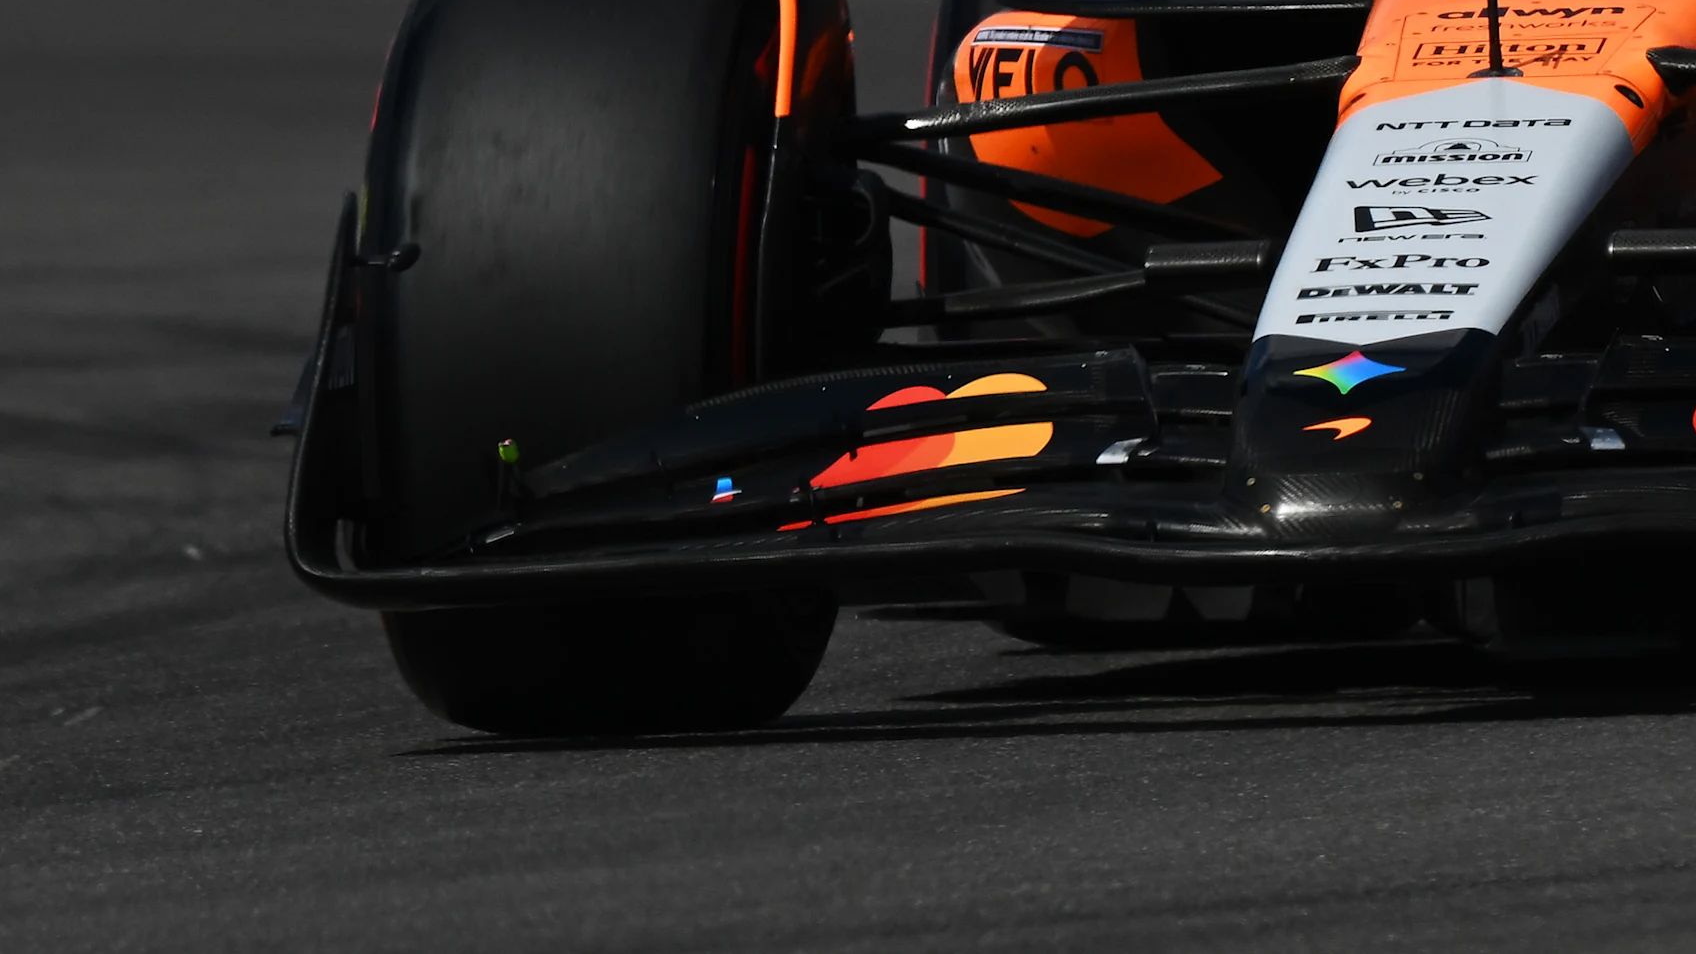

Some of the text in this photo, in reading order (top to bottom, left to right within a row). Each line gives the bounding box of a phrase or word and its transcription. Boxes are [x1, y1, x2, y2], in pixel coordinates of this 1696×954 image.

[1431, 44, 1587, 56] Hiton
[1472, 57, 1524, 66] TE
[1376, 120, 1460, 131] NTT
[1381, 152, 1524, 164] mission
[1346, 173, 1539, 189] webex
[1309, 253, 1490, 274] FxPro
[1295, 310, 1455, 325] PIRELLI
